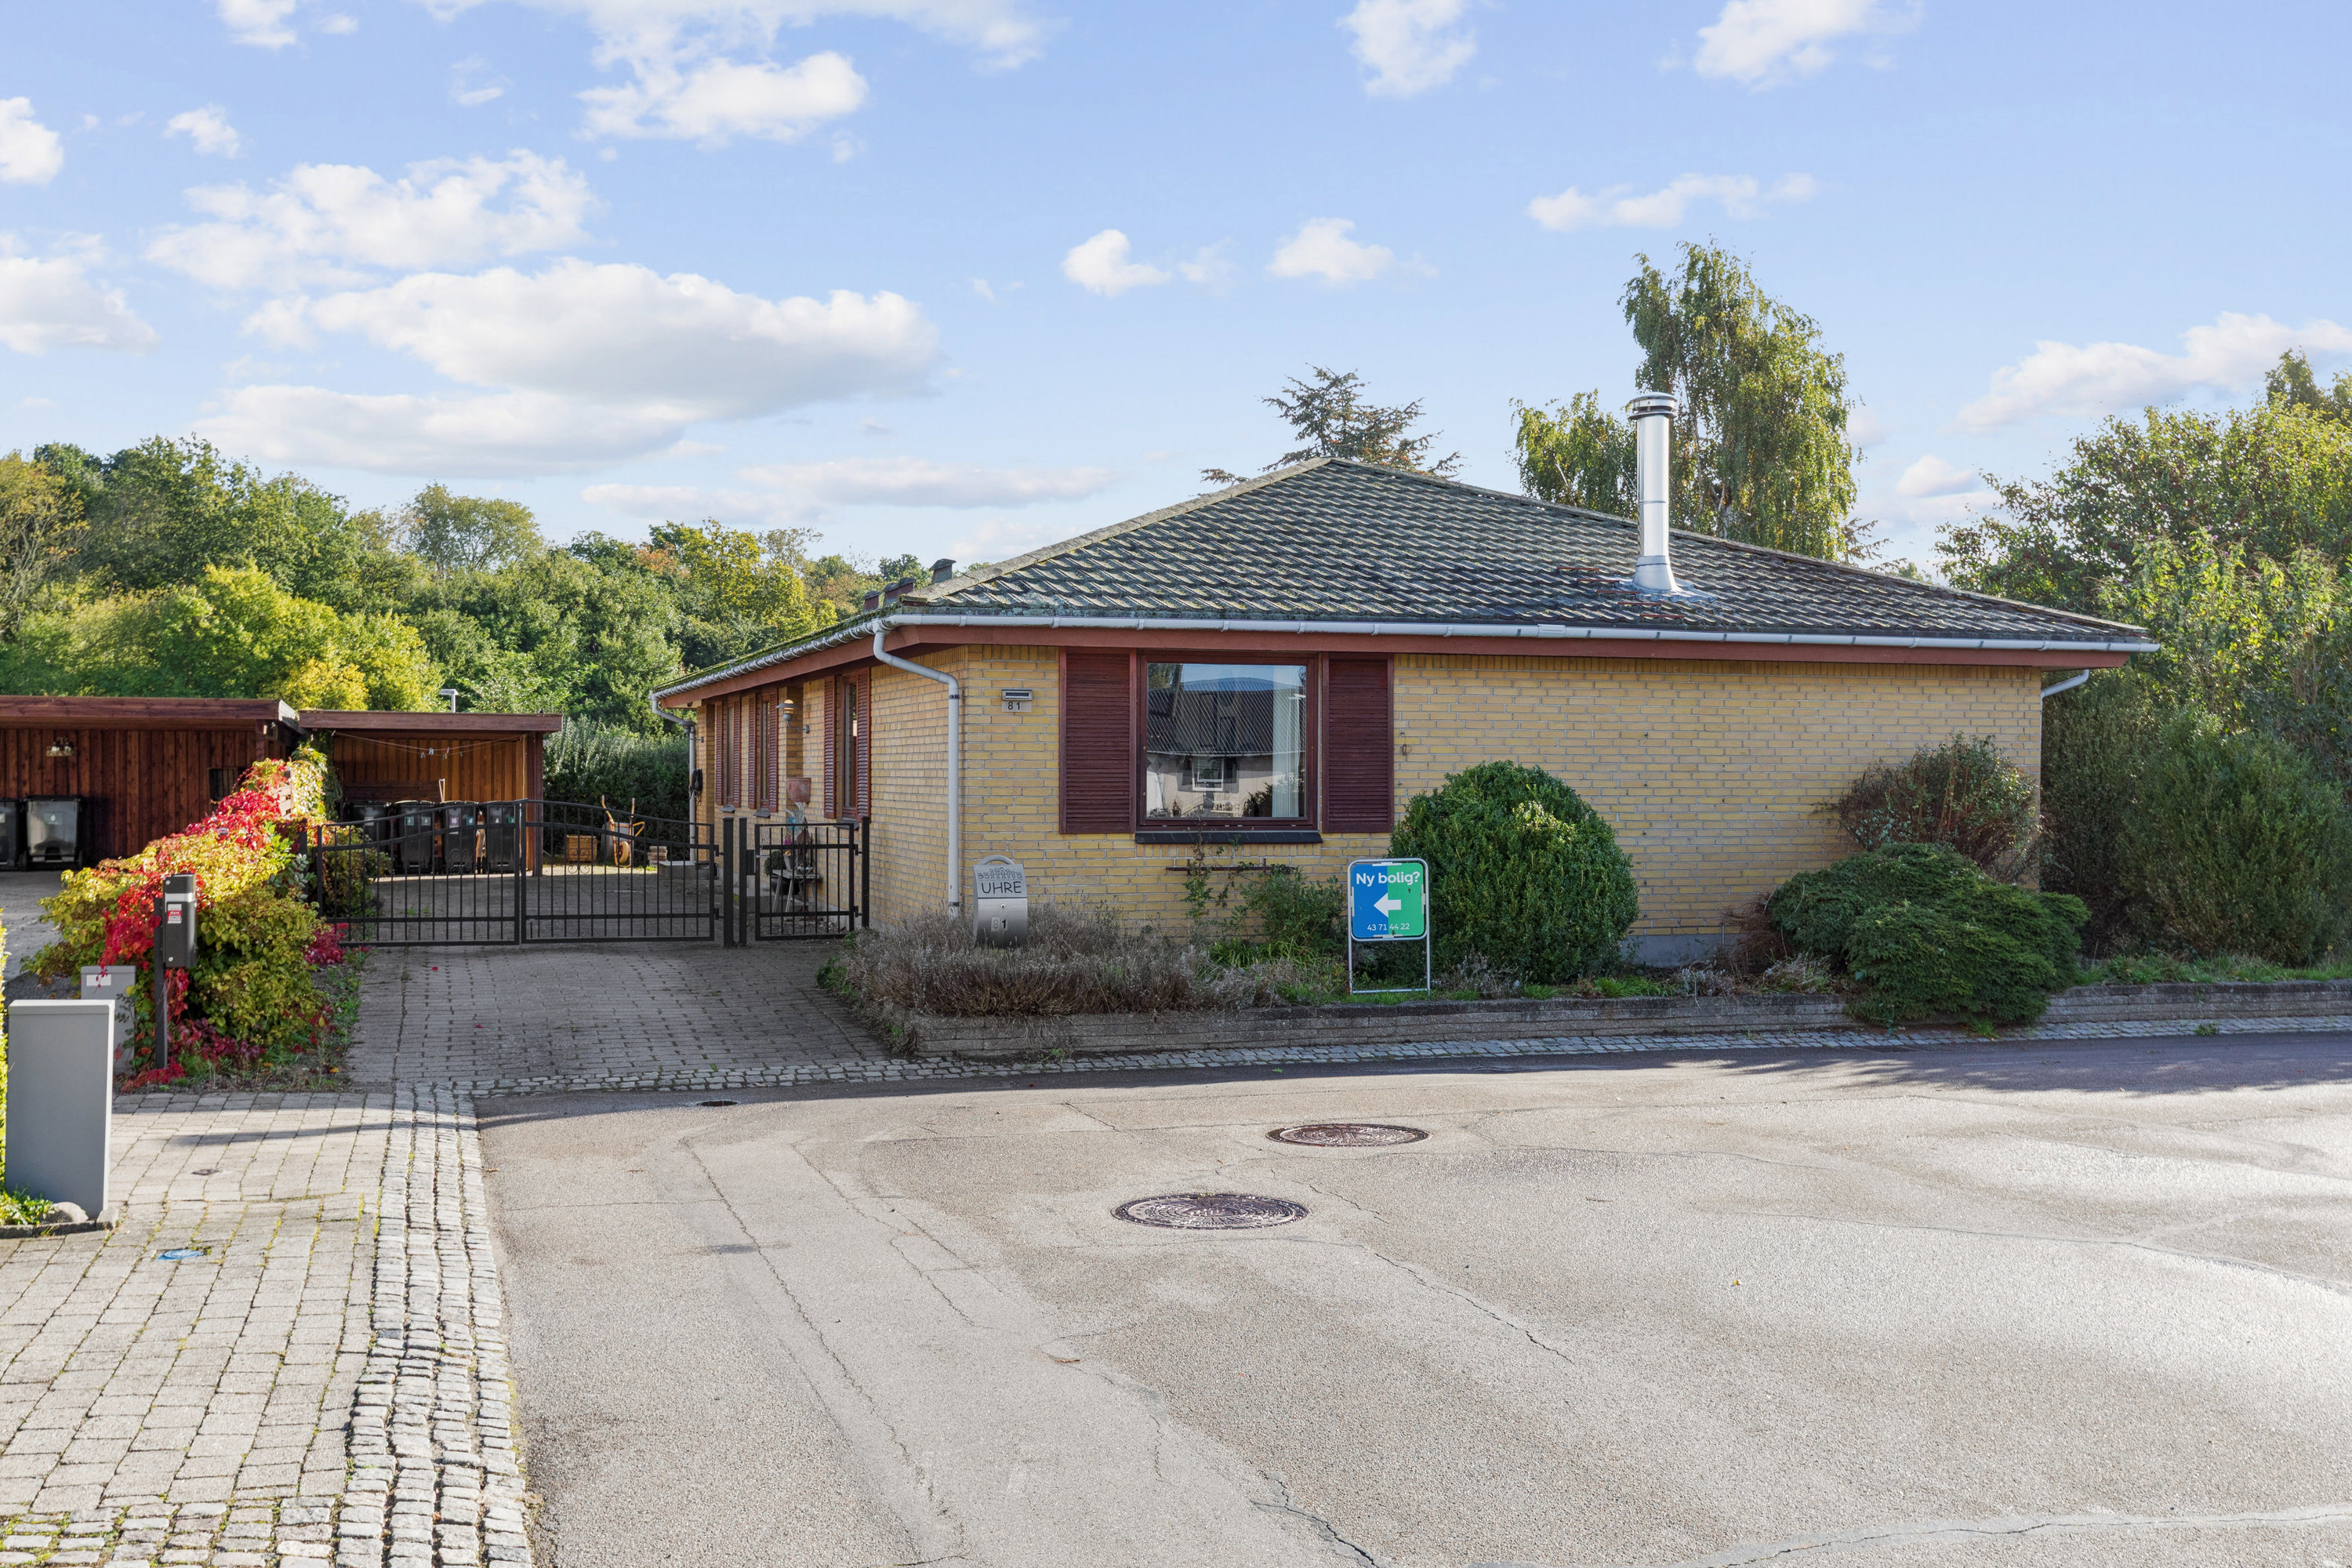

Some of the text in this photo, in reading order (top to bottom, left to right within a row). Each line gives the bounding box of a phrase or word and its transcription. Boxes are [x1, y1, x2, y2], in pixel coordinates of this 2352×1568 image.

[1007, 701, 1021, 710] 81
[1356, 871, 1421, 887] Ny bolig?
[981, 880, 1022, 894] UHRE
